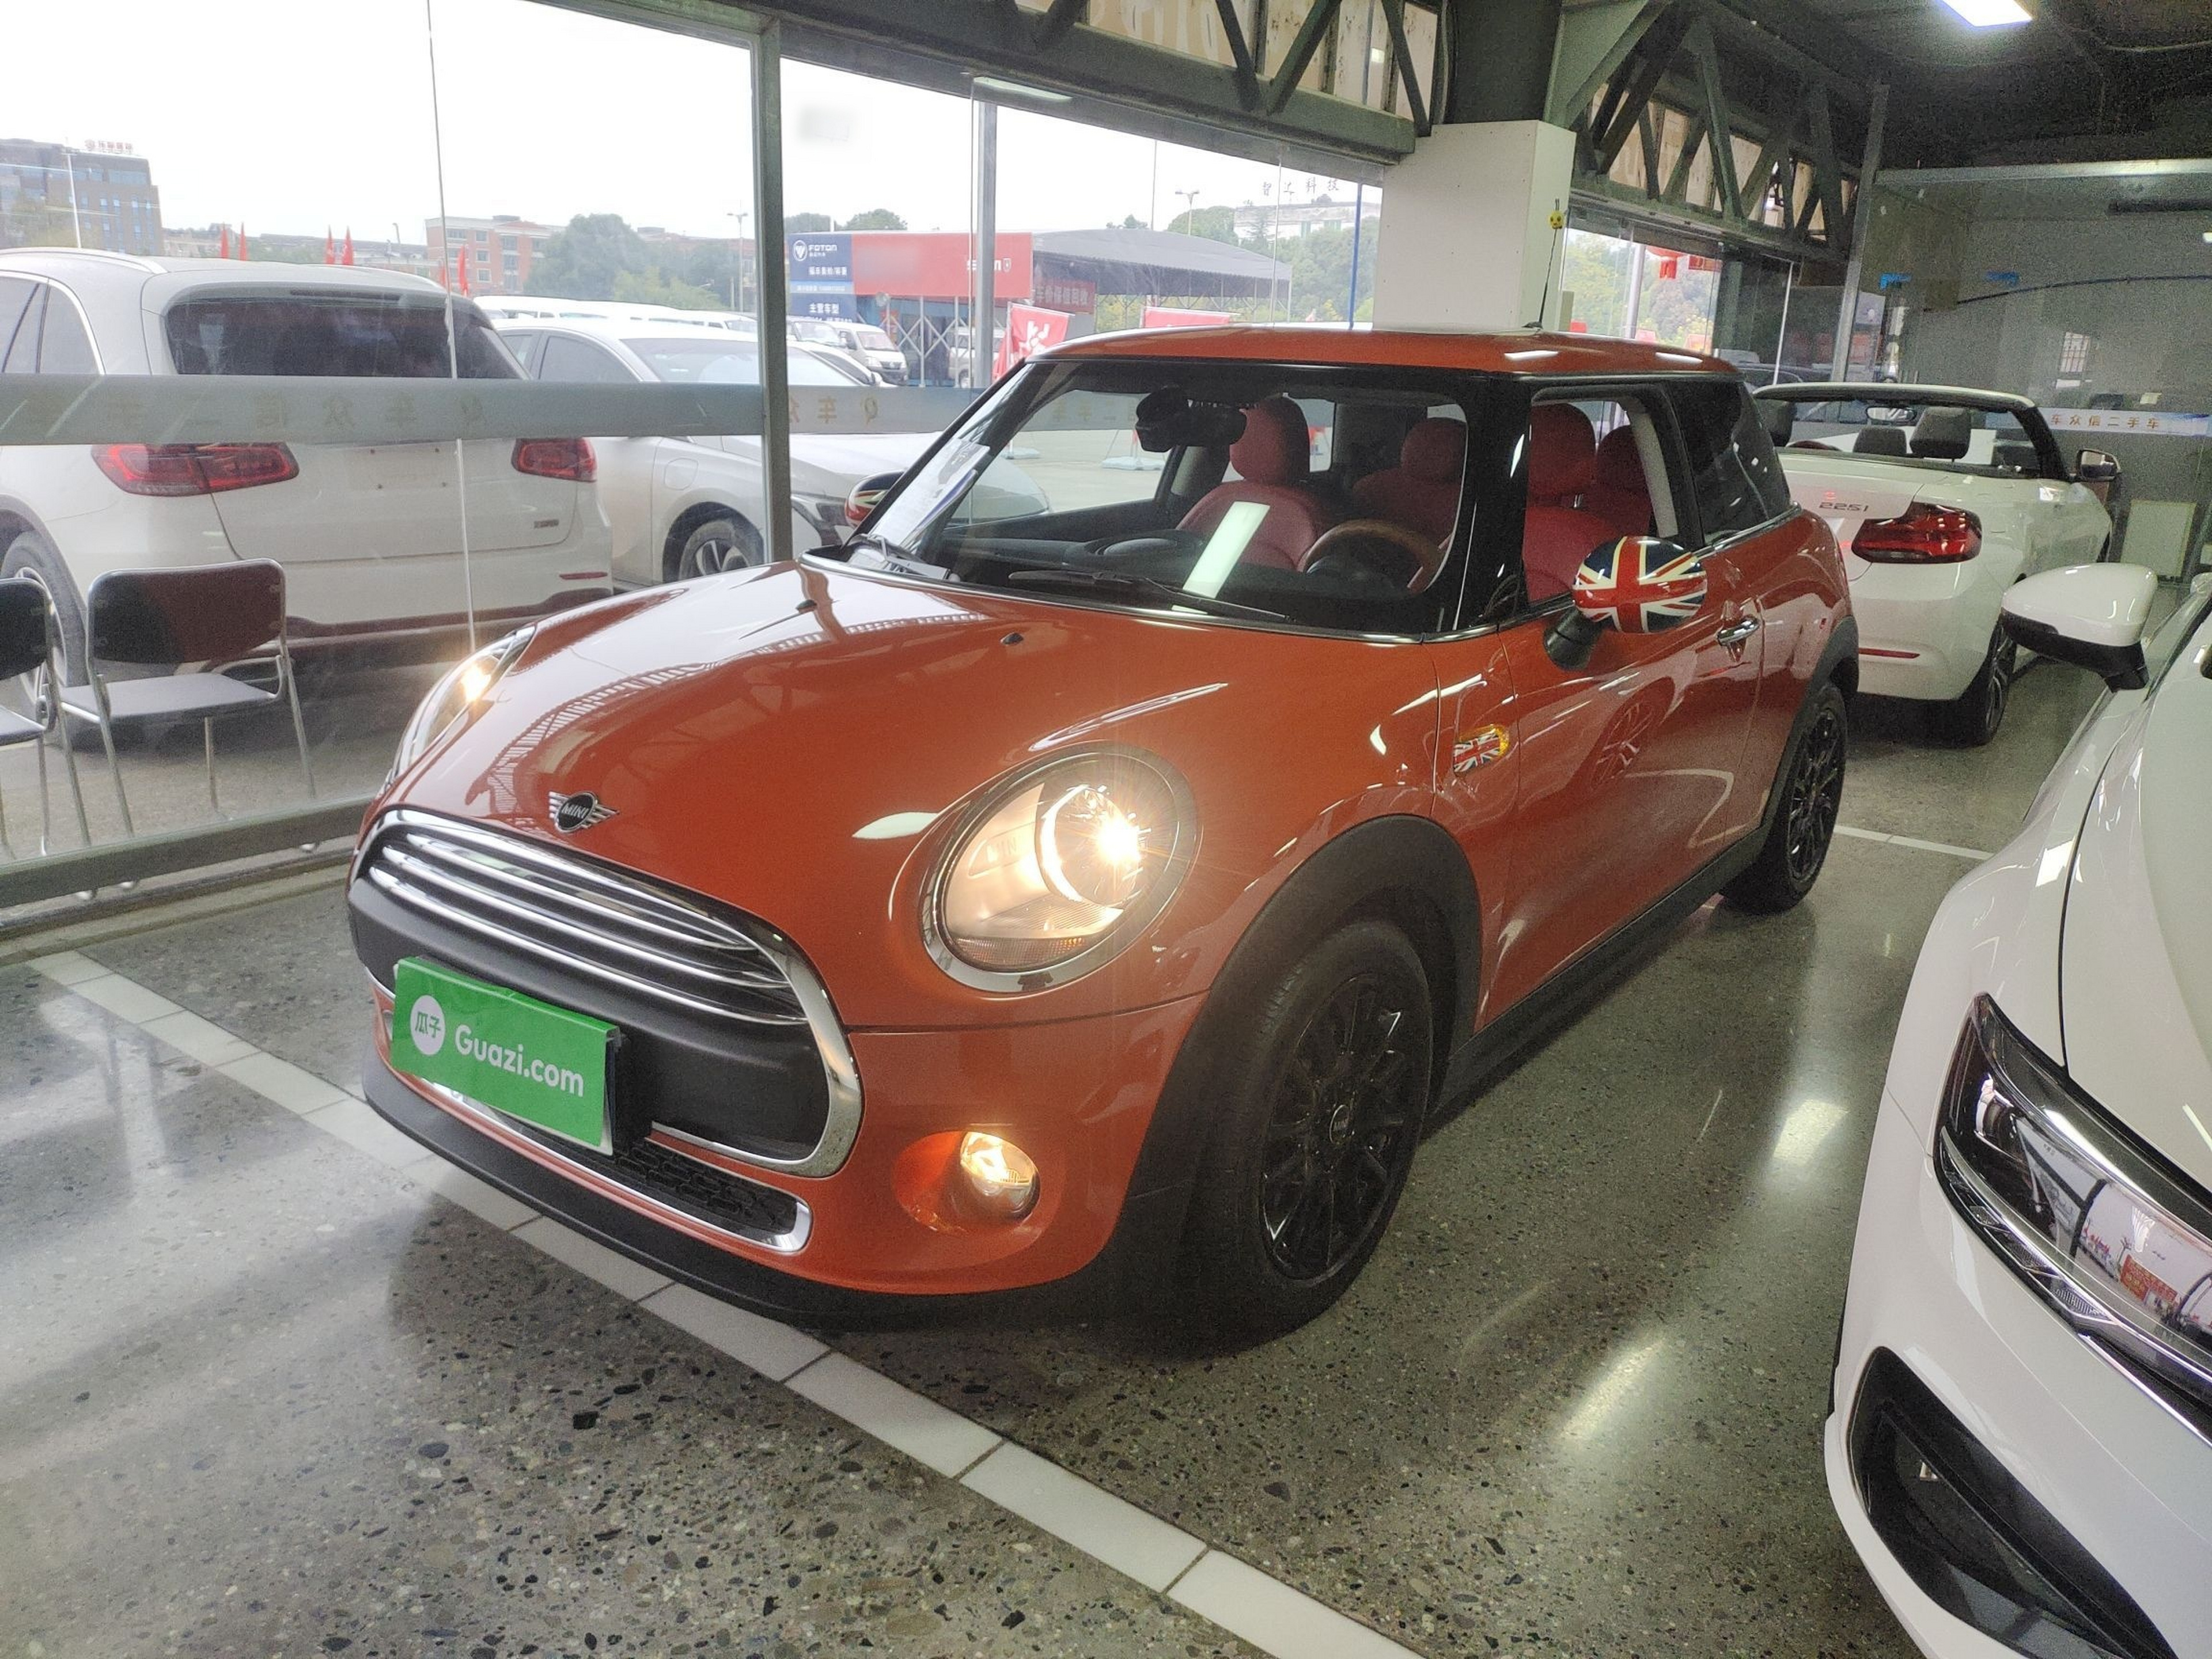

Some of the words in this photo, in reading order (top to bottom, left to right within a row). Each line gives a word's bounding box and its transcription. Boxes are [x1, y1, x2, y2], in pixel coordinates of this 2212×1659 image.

[2050, 413, 2161, 429] 车众信二手车
[561, 802, 589, 819] MINI
[415, 1011, 441, 1038] 瓜子
[454, 1024, 584, 1097] Guazi.com
